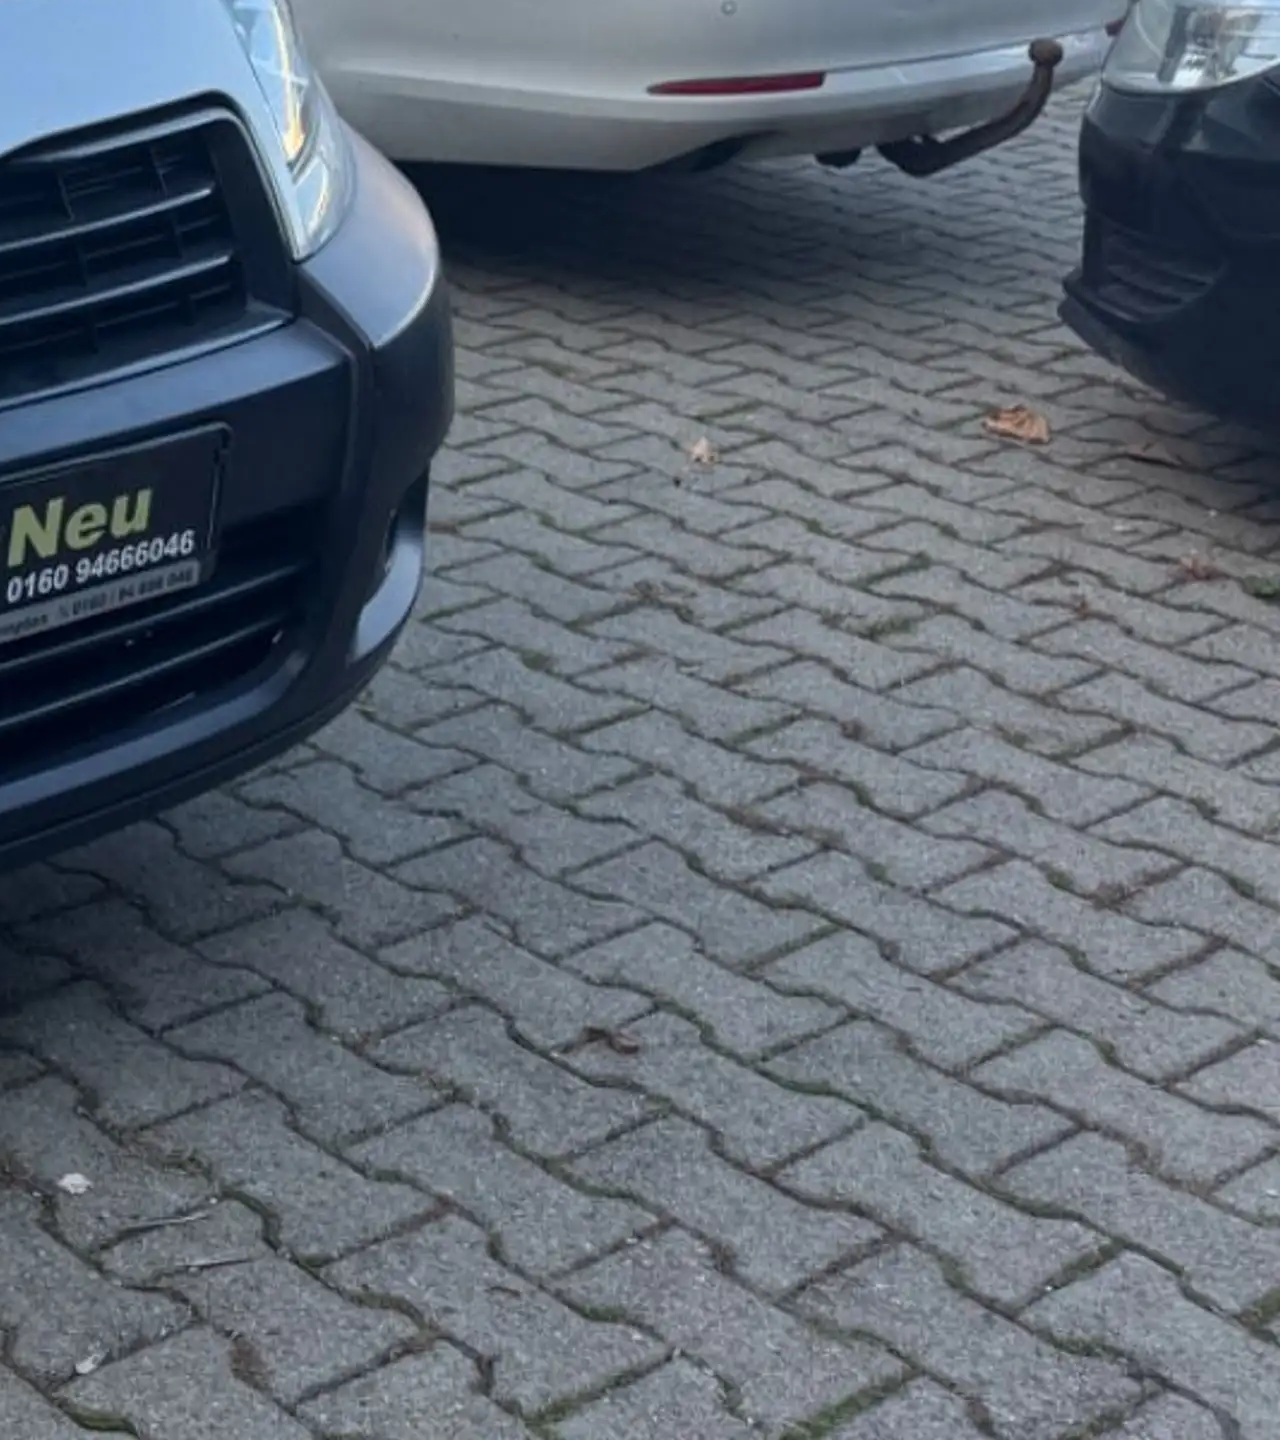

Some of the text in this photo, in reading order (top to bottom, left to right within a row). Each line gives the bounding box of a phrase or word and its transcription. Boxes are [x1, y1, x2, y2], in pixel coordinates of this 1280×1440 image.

[6, 529, 196, 604] 0160 94666046
[7, 488, 153, 569] Neu
